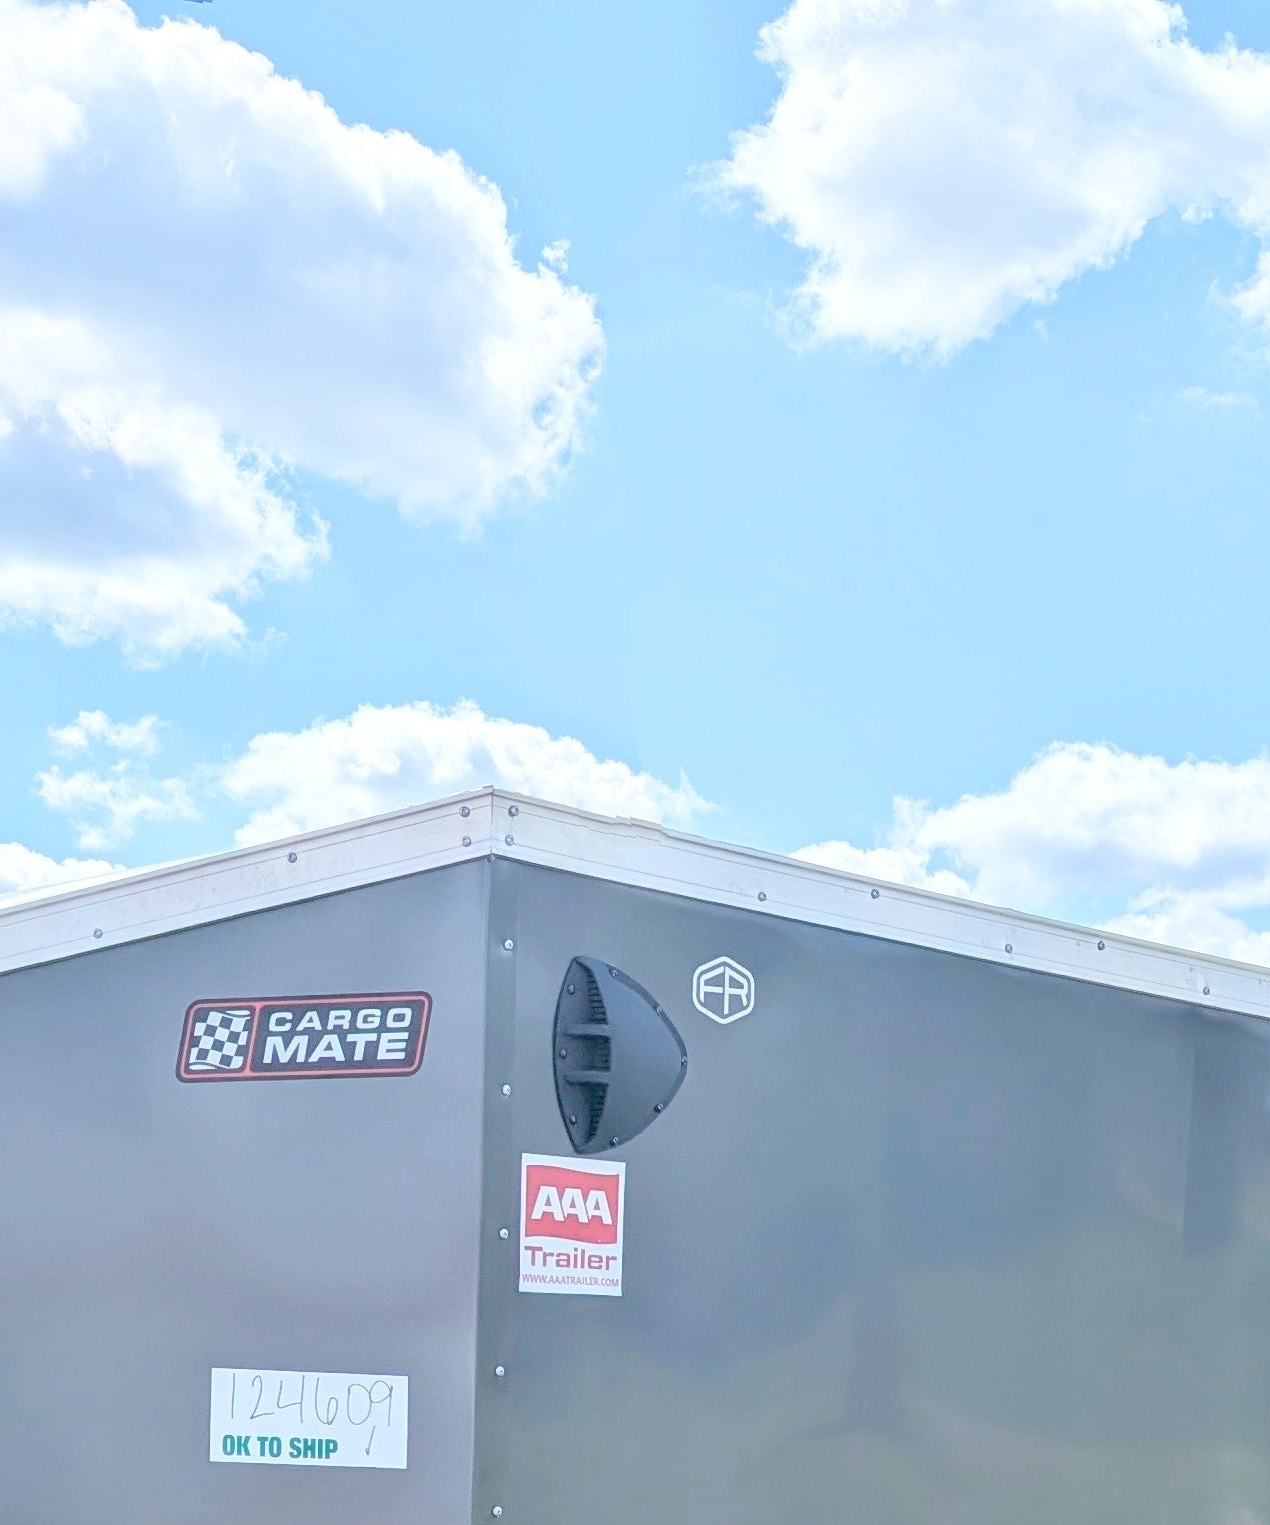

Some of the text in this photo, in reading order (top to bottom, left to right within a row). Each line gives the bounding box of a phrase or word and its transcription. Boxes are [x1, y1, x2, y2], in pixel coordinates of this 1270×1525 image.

[268, 1006, 413, 1033] CARGO
[261, 1031, 410, 1065] MATE
[531, 1185, 613, 1226] AAA
[524, 1245, 618, 1270] Trailer
[521, 1273, 619, 1287] WWW.AAATRAILER.COM
[230, 1372, 394, 1427] 124609
[222, 1434, 339, 1460] OK TO SHIP
